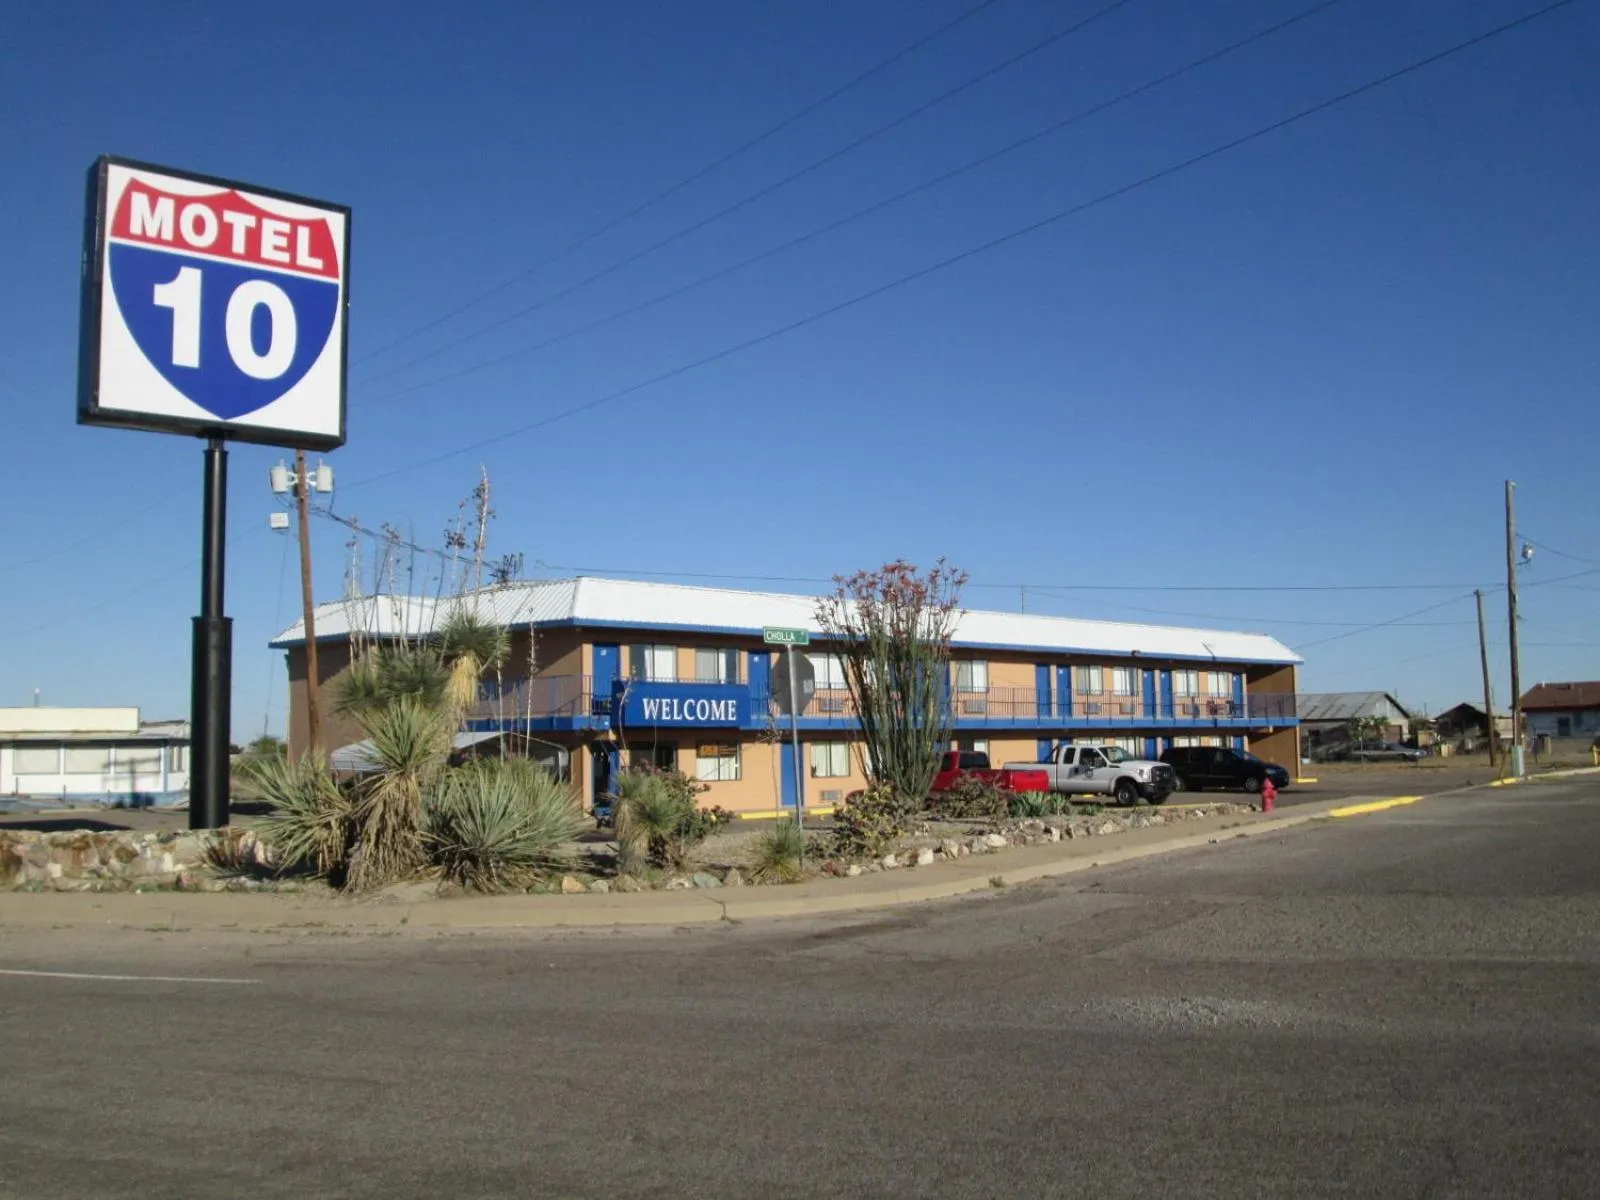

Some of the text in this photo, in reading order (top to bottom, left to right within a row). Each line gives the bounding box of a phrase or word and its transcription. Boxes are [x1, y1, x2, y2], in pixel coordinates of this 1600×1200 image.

[128, 190, 324, 270] MOTEL
[153, 265, 297, 380] 10
[766, 630, 796, 642] CHOLLA
[642, 697, 737, 721] WELCOME
